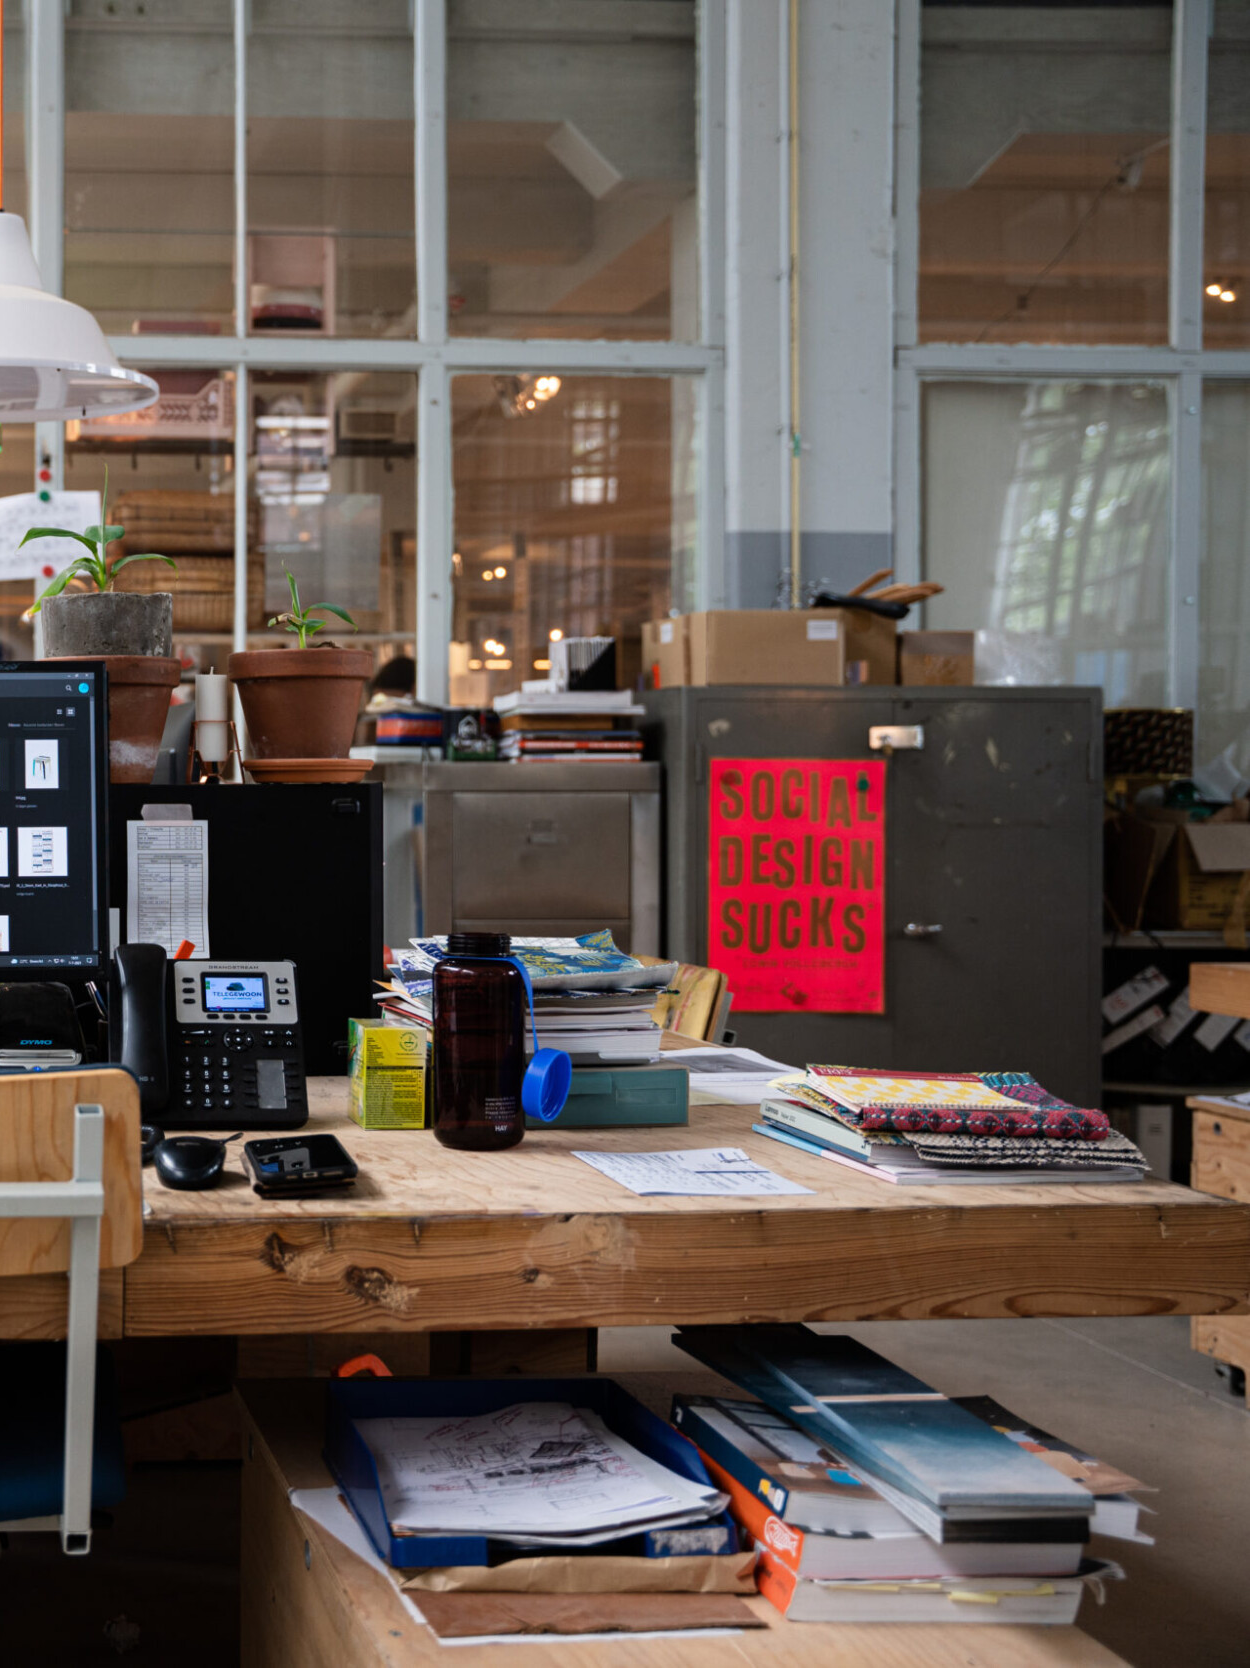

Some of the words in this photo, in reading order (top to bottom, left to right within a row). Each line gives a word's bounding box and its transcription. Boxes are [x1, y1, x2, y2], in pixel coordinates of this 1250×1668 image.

[719, 769, 878, 829] SOCIAL
[719, 833, 875, 890] DESIGN
[720, 896, 866, 953] SUCKS
